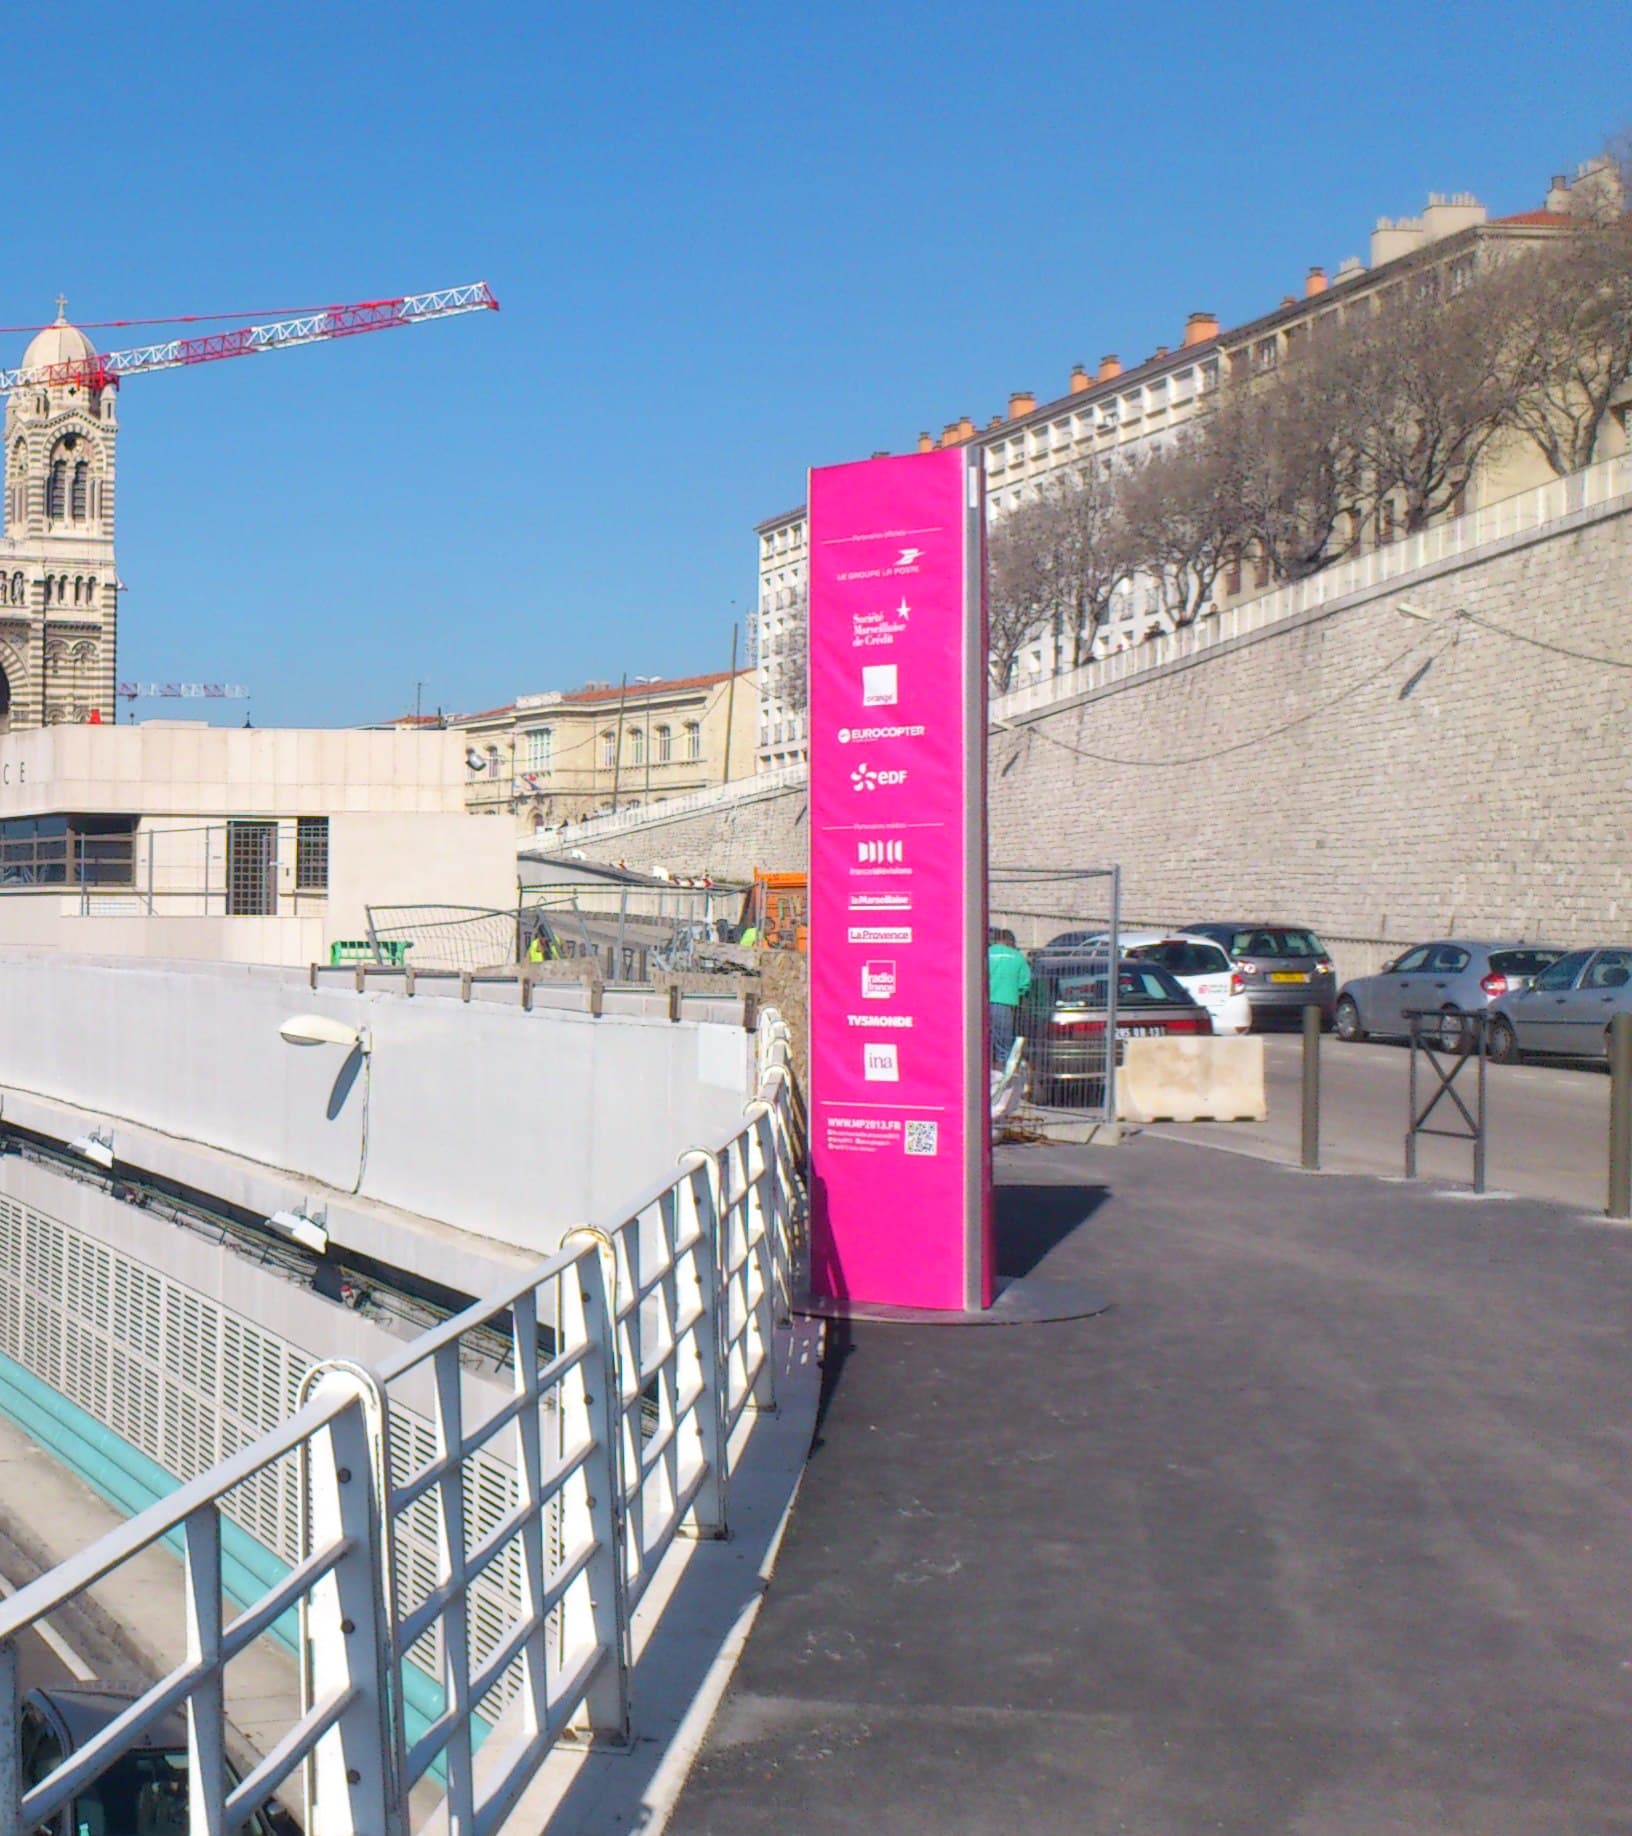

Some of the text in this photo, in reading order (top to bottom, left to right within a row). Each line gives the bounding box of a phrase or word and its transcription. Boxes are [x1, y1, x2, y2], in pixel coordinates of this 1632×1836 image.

[848, 569, 880, 580] GROUPE
[851, 725, 925, 739] EUROCOPTER
[847, 1014, 913, 1028] TV5MONDE
[868, 1051, 893, 1069] ina
